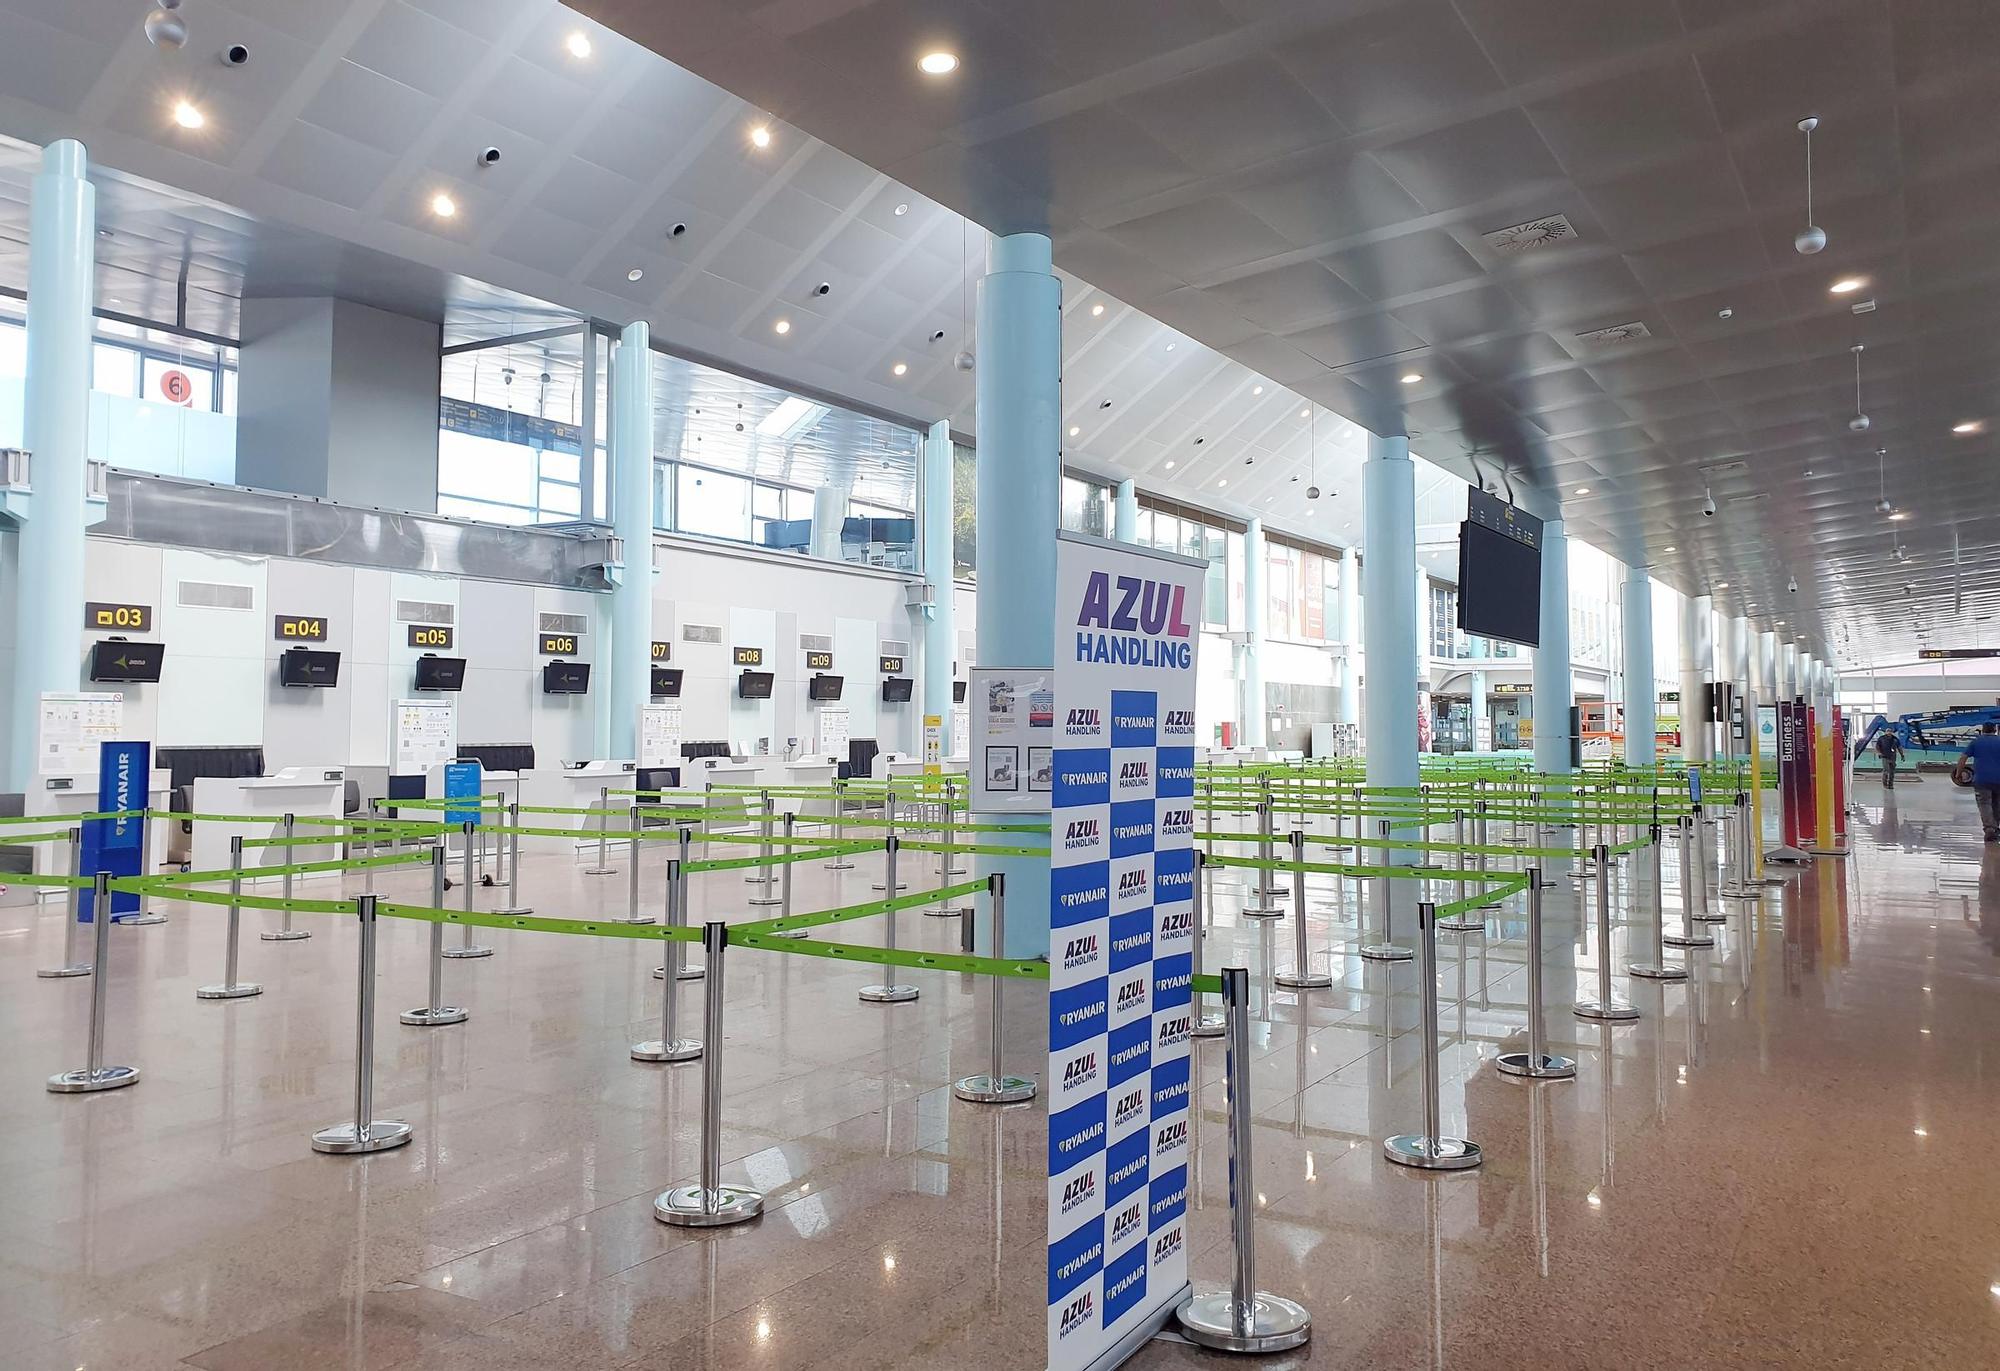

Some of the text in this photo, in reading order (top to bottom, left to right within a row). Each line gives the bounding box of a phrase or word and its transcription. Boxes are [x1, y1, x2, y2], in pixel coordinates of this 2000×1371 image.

[169, 376, 183, 396] 6
[1077, 571, 1191, 637] AZUL
[116, 608, 142, 627] 03
[298, 620, 320, 637] 04
[428, 629, 447, 644] 05
[557, 638, 573, 652] 06
[652, 644, 666, 657] 07
[1076, 632, 1191, 669] HANDLING
[746, 650, 759, 662] 08
[819, 655, 829, 666] 09
[890, 660, 899, 670] 10
[1066, 709, 1101, 726] AZUL
[1120, 716, 1154, 729] RYANAIR
[1066, 726, 1101, 736] HANDLING
[1164, 726, 1195, 735] HANDLIN
[1782, 716, 1793, 762] Business
[1068, 772, 1107, 786] RYANAIR
[1120, 762, 1148, 779] AZUL
[117, 752, 129, 825] RYANAIR
[1119, 778, 1148, 789] HANDLING
[1065, 819, 1099, 840] AZUL
[1119, 823, 1153, 840] RYANAIR
[1162, 825, 1193, 836] HANDLIN
[1065, 837, 1099, 850] HANDLING
[1118, 869, 1147, 890] AZUL
[1162, 871, 1193, 887] RYANA
[1067, 887, 1106, 907] RYANAIR
[1118, 886, 1147, 900] HANDLING
[1160, 912, 1193, 932] AZUL
[1065, 934, 1098, 960] AZUL
[1118, 931, 1151, 952] RYANAIR
[1064, 952, 1098, 970] HANDLING
[1117, 979, 1145, 1004] AZUL
[1066, 1001, 1105, 1026] RYANAIR
[1116, 995, 1145, 1013] HANDLING
[1159, 1016, 1191, 1040] AZUL
[1116, 1040, 1150, 1066] RYANAIR
[1063, 1052, 1096, 1082] AZUL
[1063, 1070, 1097, 1093] HANDLING
[1115, 1089, 1143, 1118] AZUL
[1114, 1105, 1143, 1128] HANDLING
[1065, 1121, 1104, 1153] RYANAIR
[1157, 1120, 1187, 1148] AZUL
[1156, 1136, 1188, 1157] HANDLING
[1113, 1154, 1148, 1185] RYANAIR
[1062, 1170, 1095, 1205] AZUL
[1061, 1187, 1095, 1215] HANDLING
[1155, 1188, 1186, 1218] RYANAI
[1112, 1202, 1140, 1236] AZUL
[1111, 1218, 1141, 1246] HANDLING
[1154, 1227, 1182, 1258] AZUL
[1063, 1243, 1102, 1279] RYANAIR
[1153, 1241, 1182, 1267] HANDLING
[1111, 1264, 1145, 1299] RYANAIR
[1060, 1291, 1093, 1330] AZUL
[1059, 1308, 1093, 1341] HANDLING
